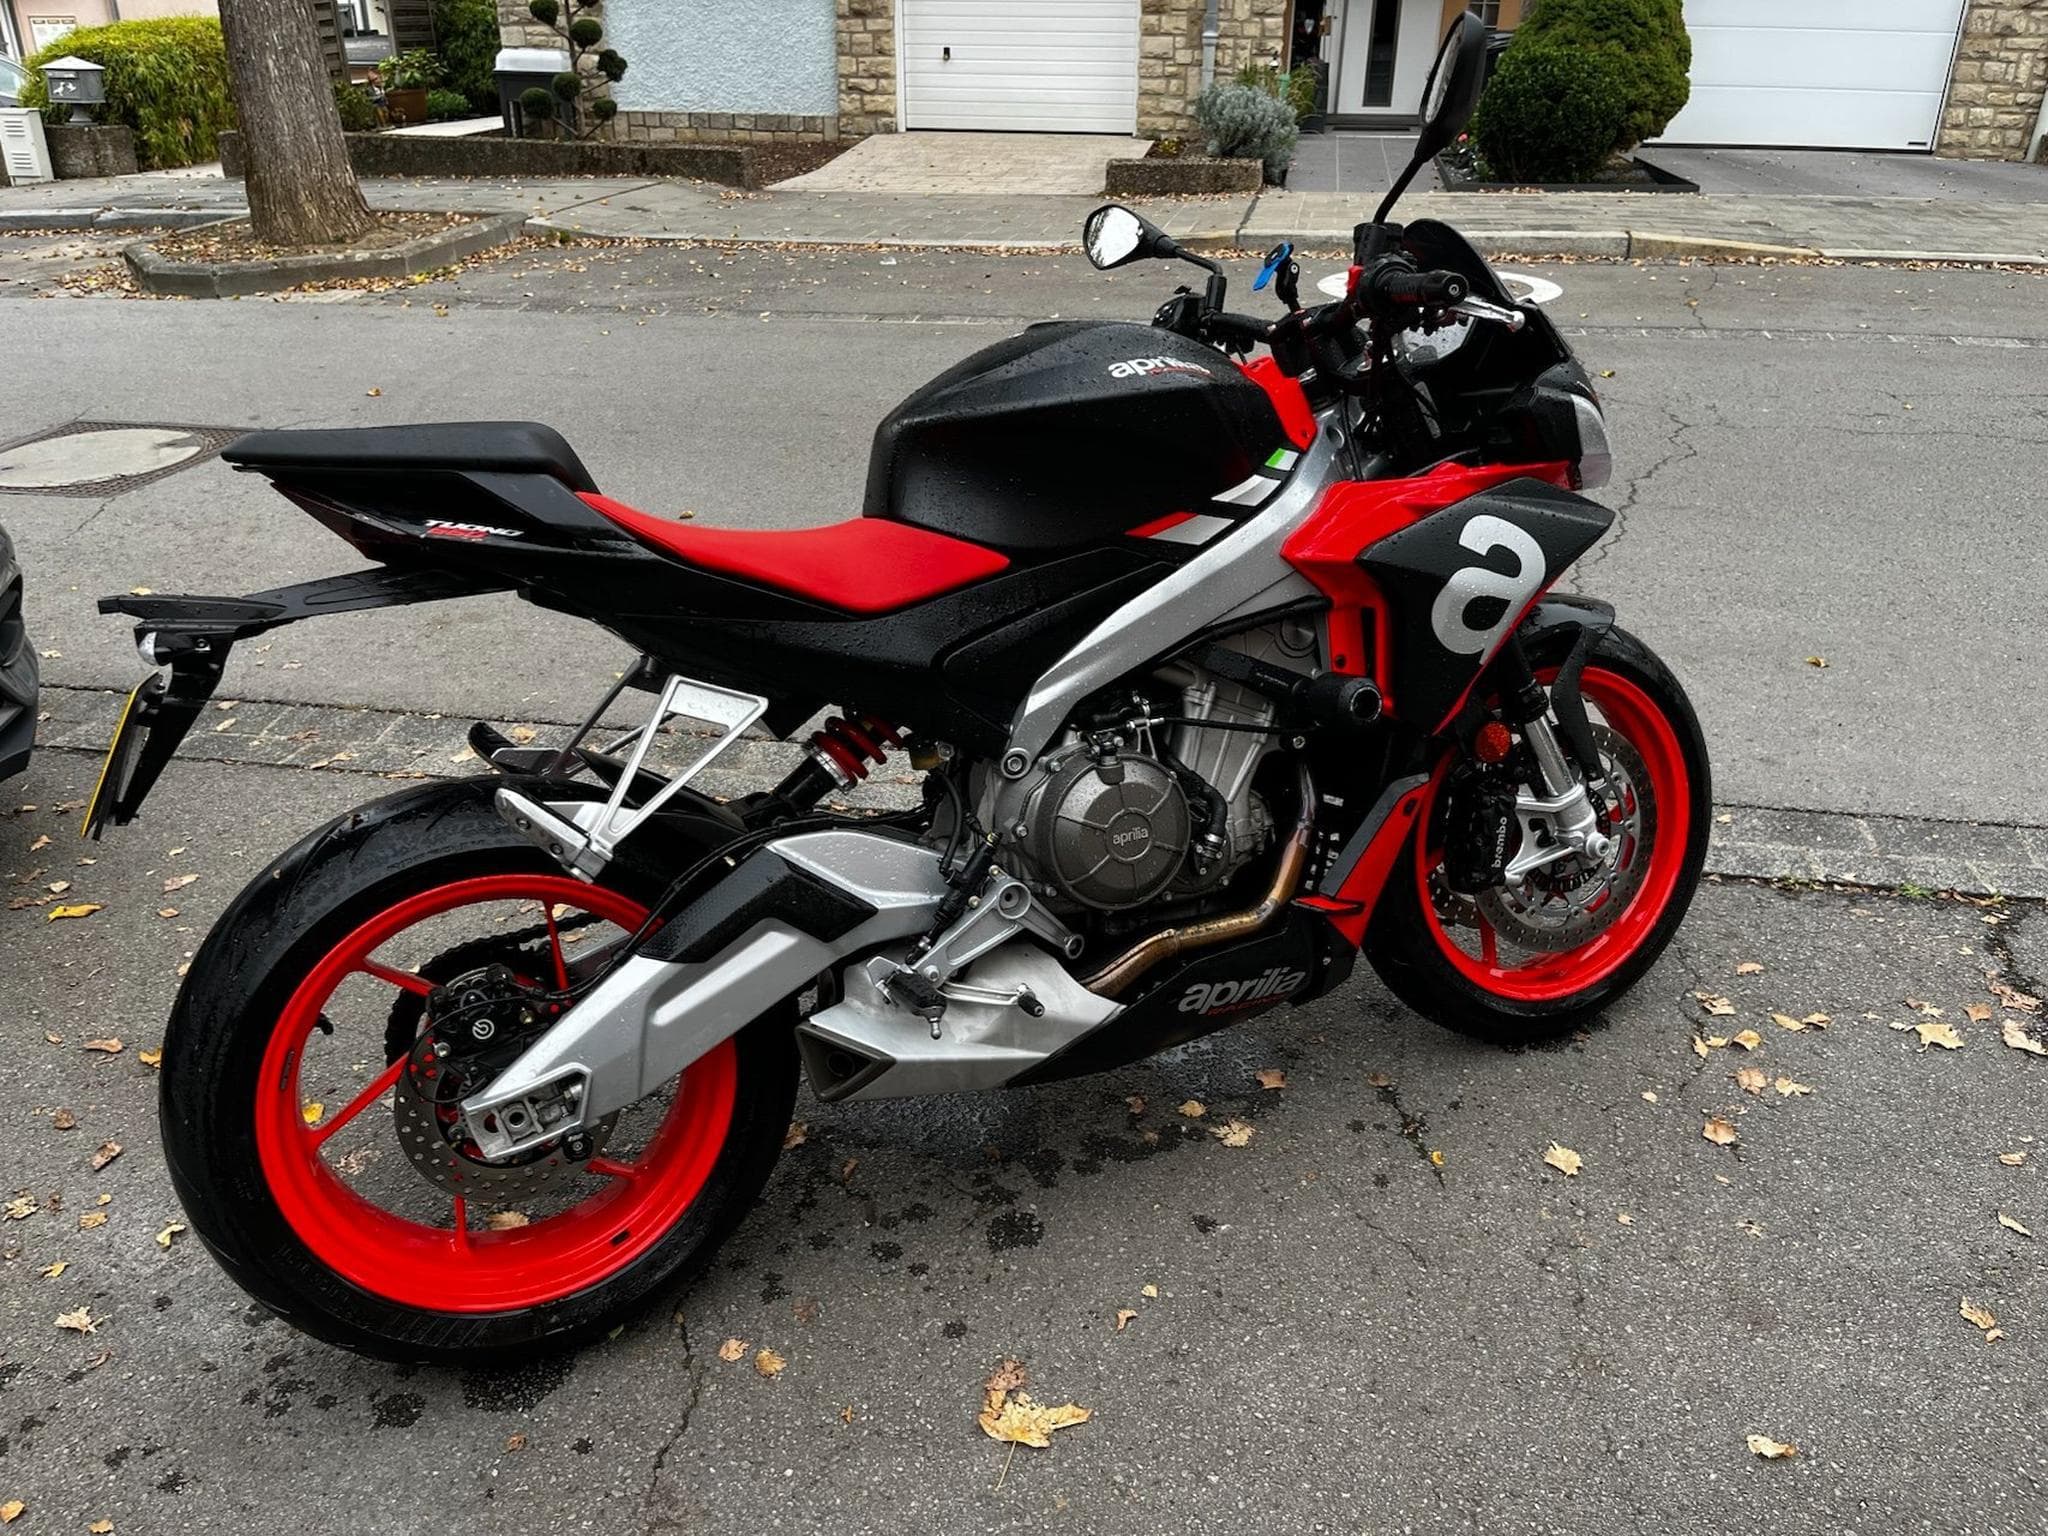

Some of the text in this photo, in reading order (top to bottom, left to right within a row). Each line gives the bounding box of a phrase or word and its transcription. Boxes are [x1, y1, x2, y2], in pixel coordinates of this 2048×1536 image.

[1112, 826, 1149, 846] aprilia
[1492, 816, 1508, 869] brembo
[1178, 966, 1306, 1015] aprilia
